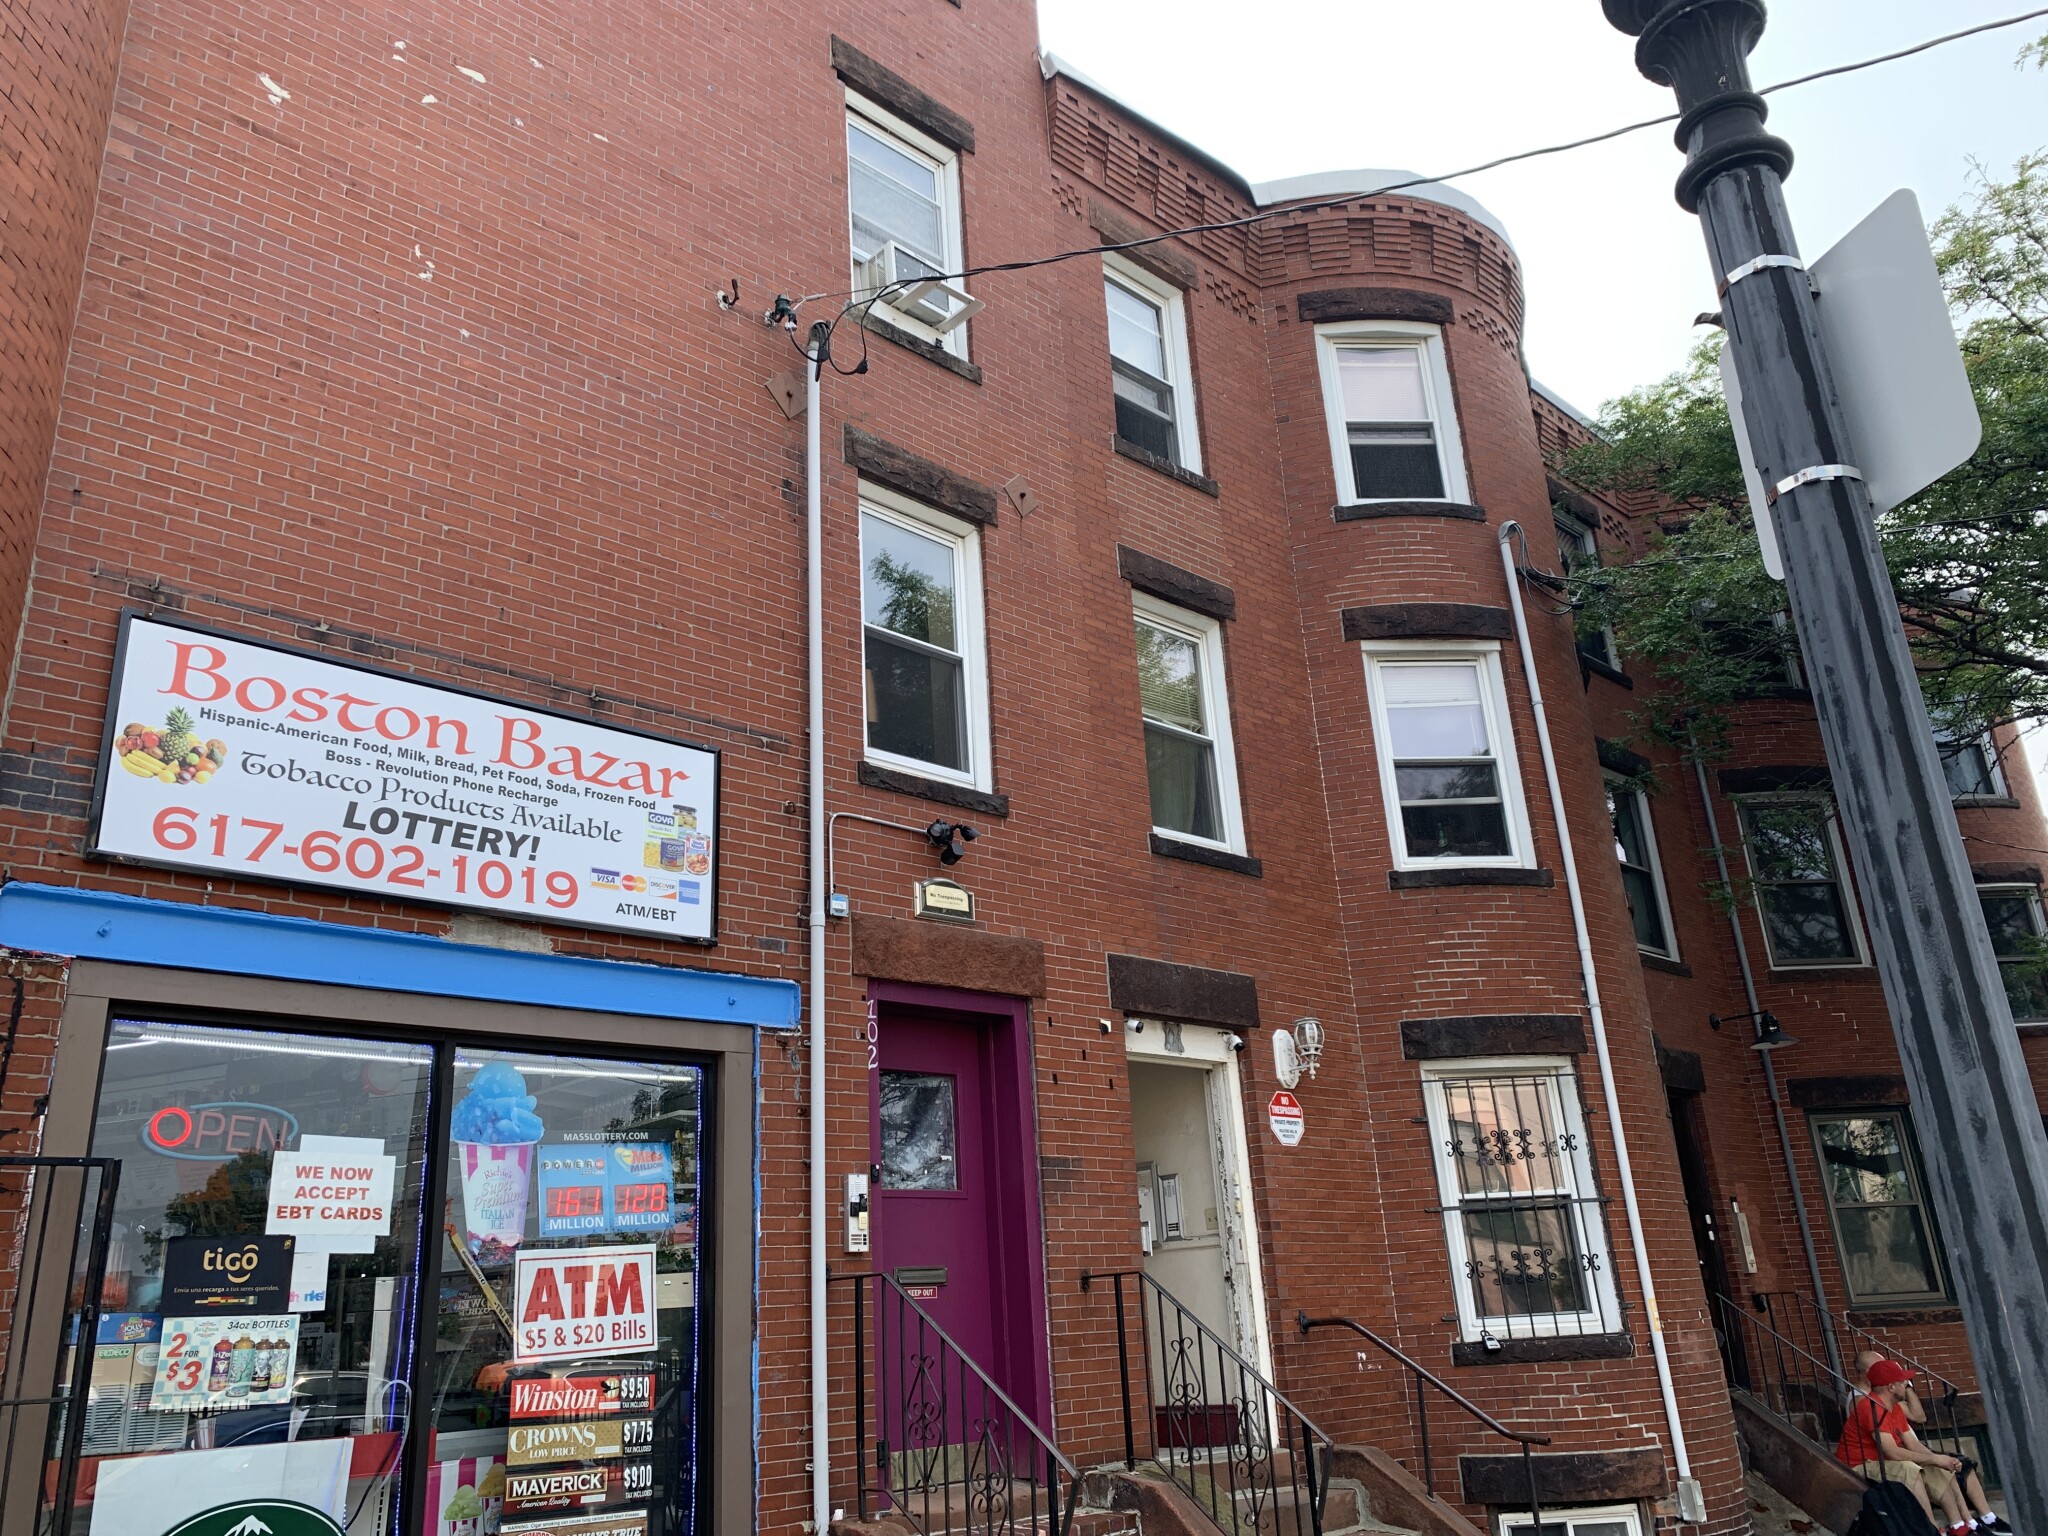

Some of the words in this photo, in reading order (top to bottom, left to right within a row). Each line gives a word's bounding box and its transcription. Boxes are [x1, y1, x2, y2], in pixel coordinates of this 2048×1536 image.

[157, 640, 475, 754] Boston
[489, 715, 691, 799] Bazar
[200, 707, 348, 747] Hispanic-American
[354, 737, 392, 758] Food,
[397, 747, 430, 766] Milk,
[435, 755, 478, 776] Bread,
[482, 766, 503, 779] Pet
[508, 771, 542, 790] Food,
[546, 780, 580, 797] Soda,
[584, 787, 624, 804] Frozen
[628, 795, 656, 810] Food
[325, 749, 361, 767] Boss
[376, 759, 448, 785] Revolution
[453, 777, 493, 794] Phone
[498, 785, 558, 807] Recharge
[241, 751, 372, 794] Tobacco
[373, 777, 505, 821] Products
[510, 804, 624, 843] Available
[648, 812, 675, 827] GOYA
[342, 801, 541, 862] LOTTERY!
[153, 806, 579, 909] 617-602-1019
[597, 874, 616, 885] VISA
[651, 881, 676, 890] DISCOVER
[616, 902, 677, 922] ATM/EBT
[867, 999, 879, 1070] 102
[1281, 1096, 1289, 1106] NO
[151, 1107, 288, 1153] OPEN
[563, 1131, 649, 1142] MASSLOTTERY.COM
[295, 1165, 324, 1180] WE
[330, 1166, 374, 1181] NOW
[294, 1185, 370, 1200] ACCEPT
[556, 1187, 600, 1217] 161
[623, 1183, 666, 1214] 128
[276, 1205, 315, 1219] EBT
[320, 1206, 383, 1220] CARDS
[481, 1207, 515, 1220] ITALIAN
[549, 1217, 604, 1230] MILLION
[618, 1213, 670, 1227] MILLION
[491, 1219, 505, 1230] ICE
[523, 1261, 646, 1323] ATM
[908, 1289, 921, 1297] KEEP
[922, 1289, 934, 1297] OUT
[123, 1322, 144, 1333] JOLLY
[227, 1320, 250, 1330] 34oz
[251, 1319, 290, 1329] BOTTLES
[525, 1326, 547, 1351] $5
[553, 1326, 567, 1347] &
[573, 1323, 605, 1347] $20
[612, 1319, 646, 1341] Bills
[166, 1332, 188, 1358] 2
[184, 1350, 199, 1358] FOR
[166, 1360, 203, 1391] $3
[515, 1383, 599, 1413] Winston
[621, 1377, 650, 1399] $9.50
[510, 1425, 596, 1453] CROWNS
[624, 1421, 653, 1444] $7.75
[530, 1448, 548, 1459] LOW
[551, 1446, 577, 1457] PRICE
[512, 1473, 603, 1497] MAVERICK
[624, 1465, 652, 1490] $9.00
[517, 1499, 548, 1509] American
[549, 1497, 571, 1507] Quality
